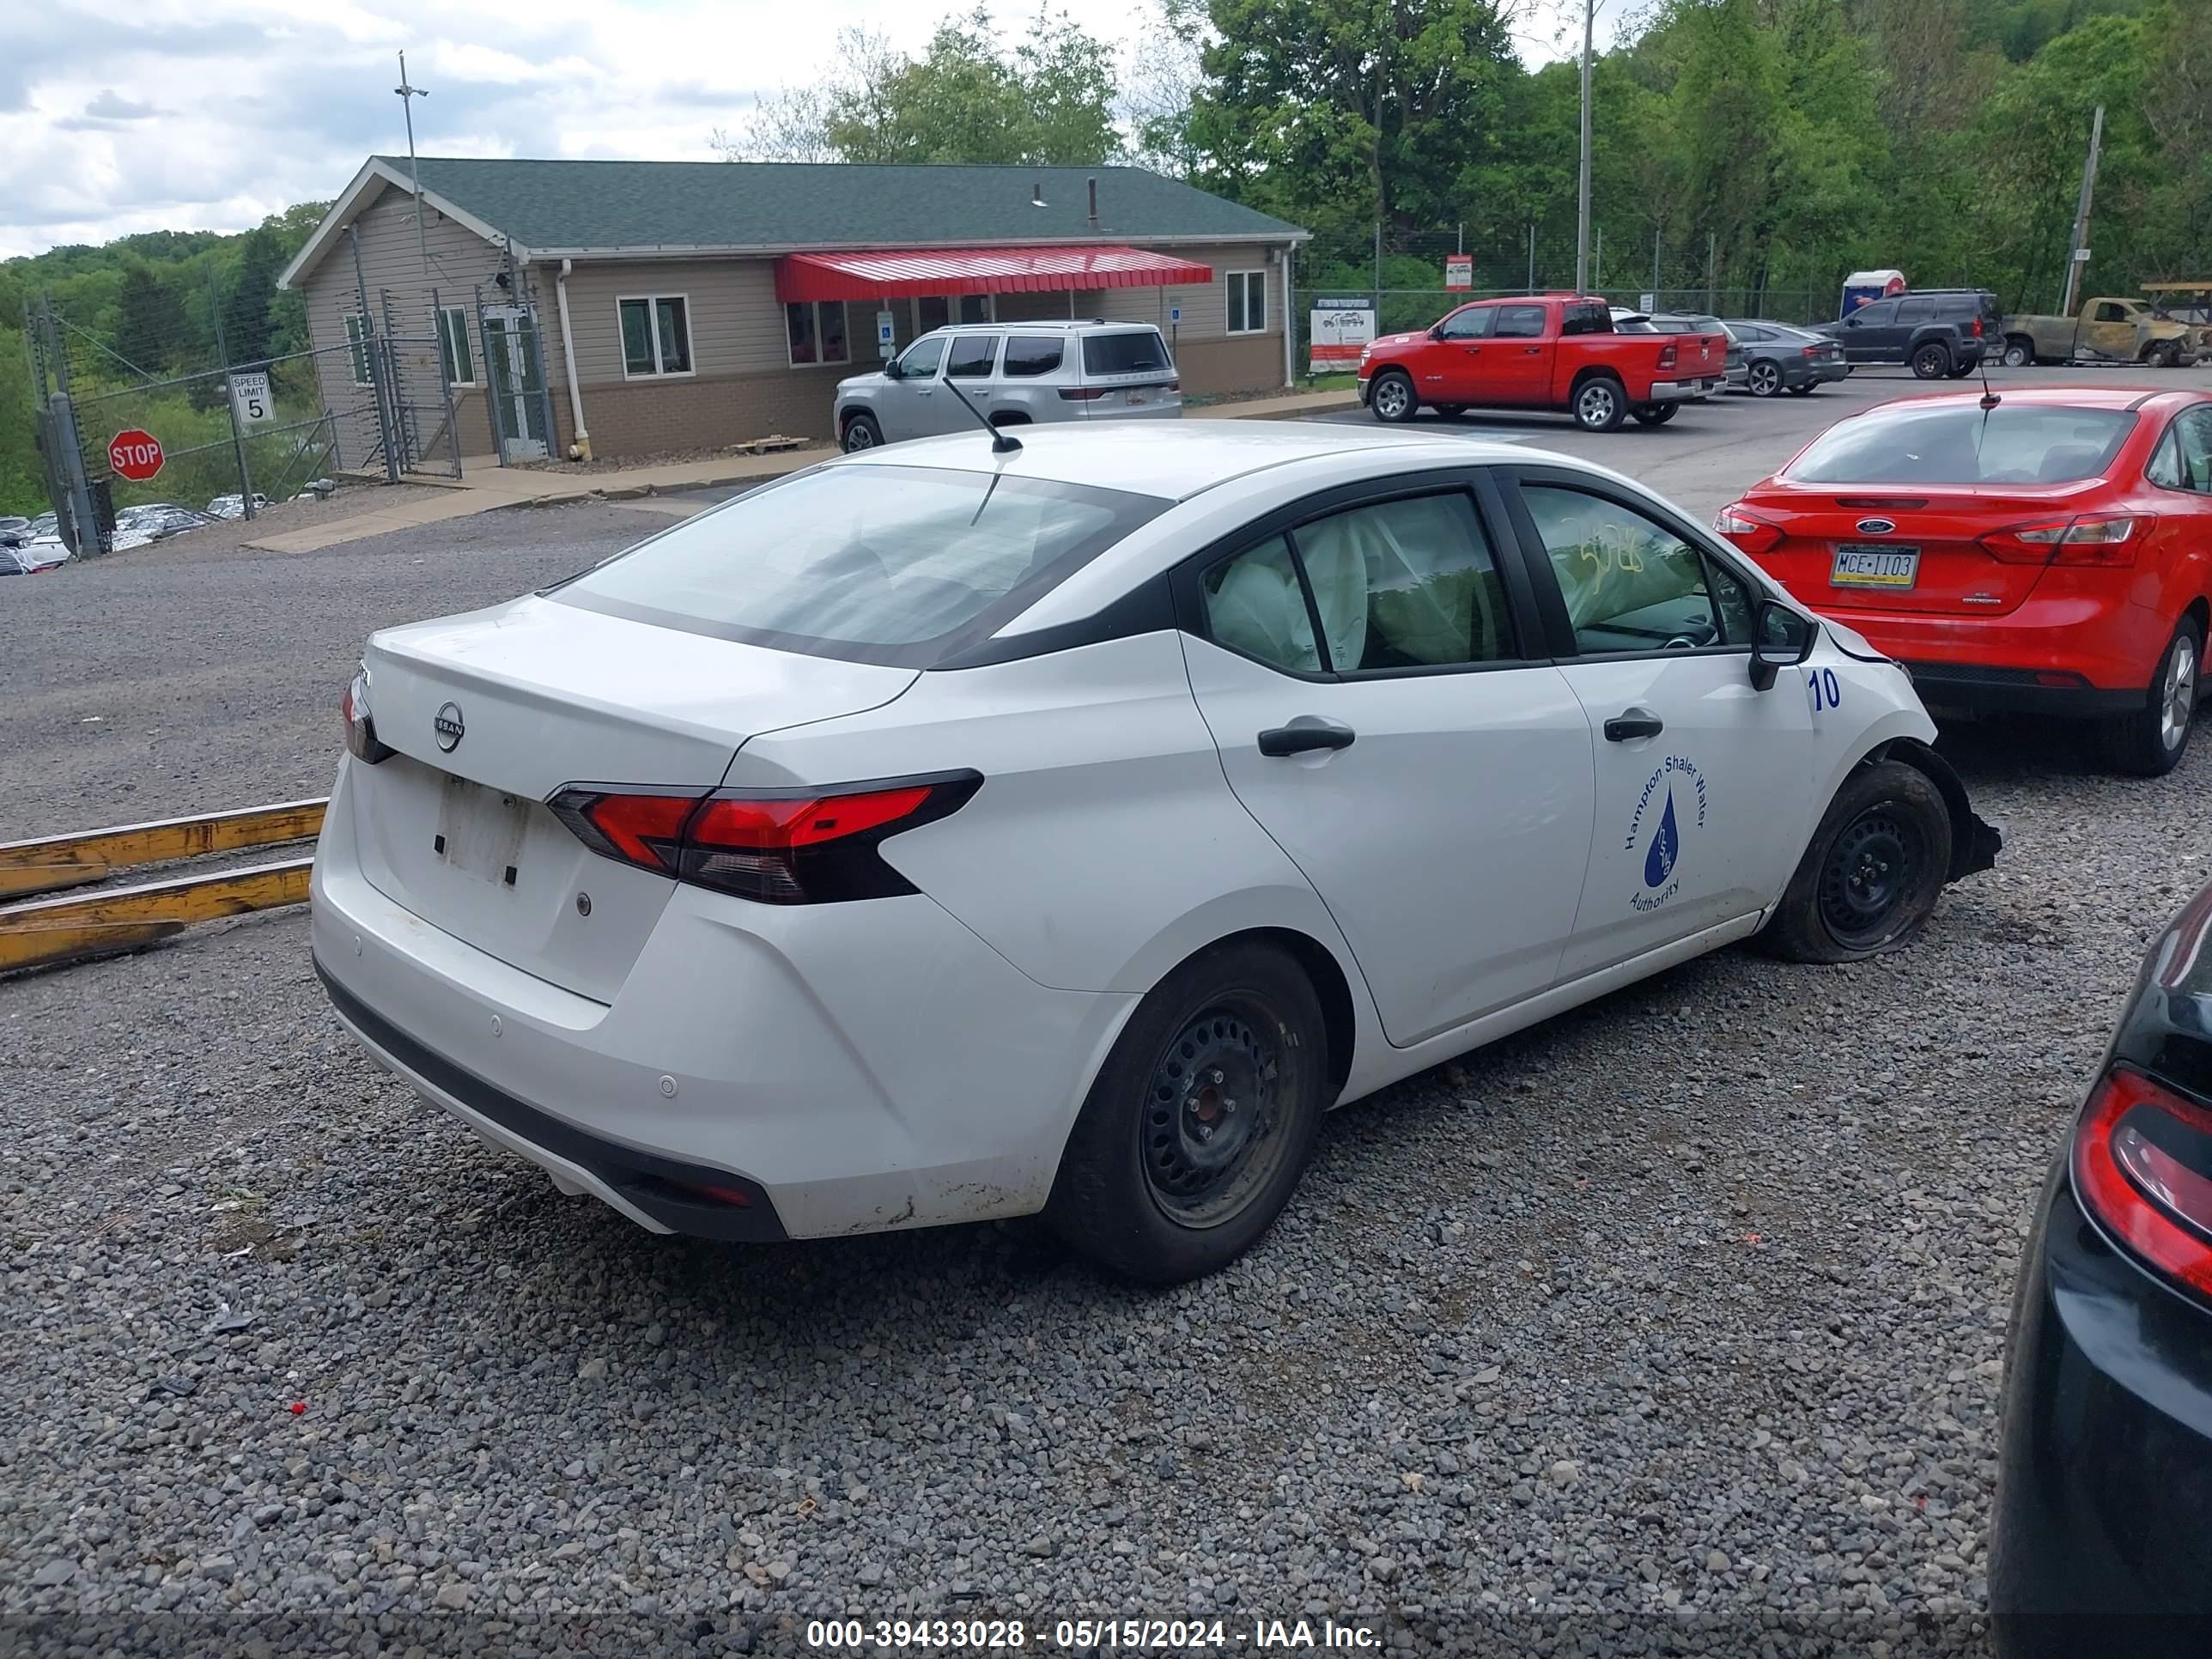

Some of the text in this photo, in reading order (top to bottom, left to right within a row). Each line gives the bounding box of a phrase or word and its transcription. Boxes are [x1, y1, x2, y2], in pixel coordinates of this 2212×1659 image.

[234, 375, 265, 387] SPEED
[238, 386, 264, 398] LIMIT
[248, 398, 264, 419] 5
[112, 442, 160, 469] STOP
[1808, 667, 1840, 711] 10
[1625, 755, 1708, 850] Hampton Shaler Water
[1630, 878, 1680, 912] Authority
